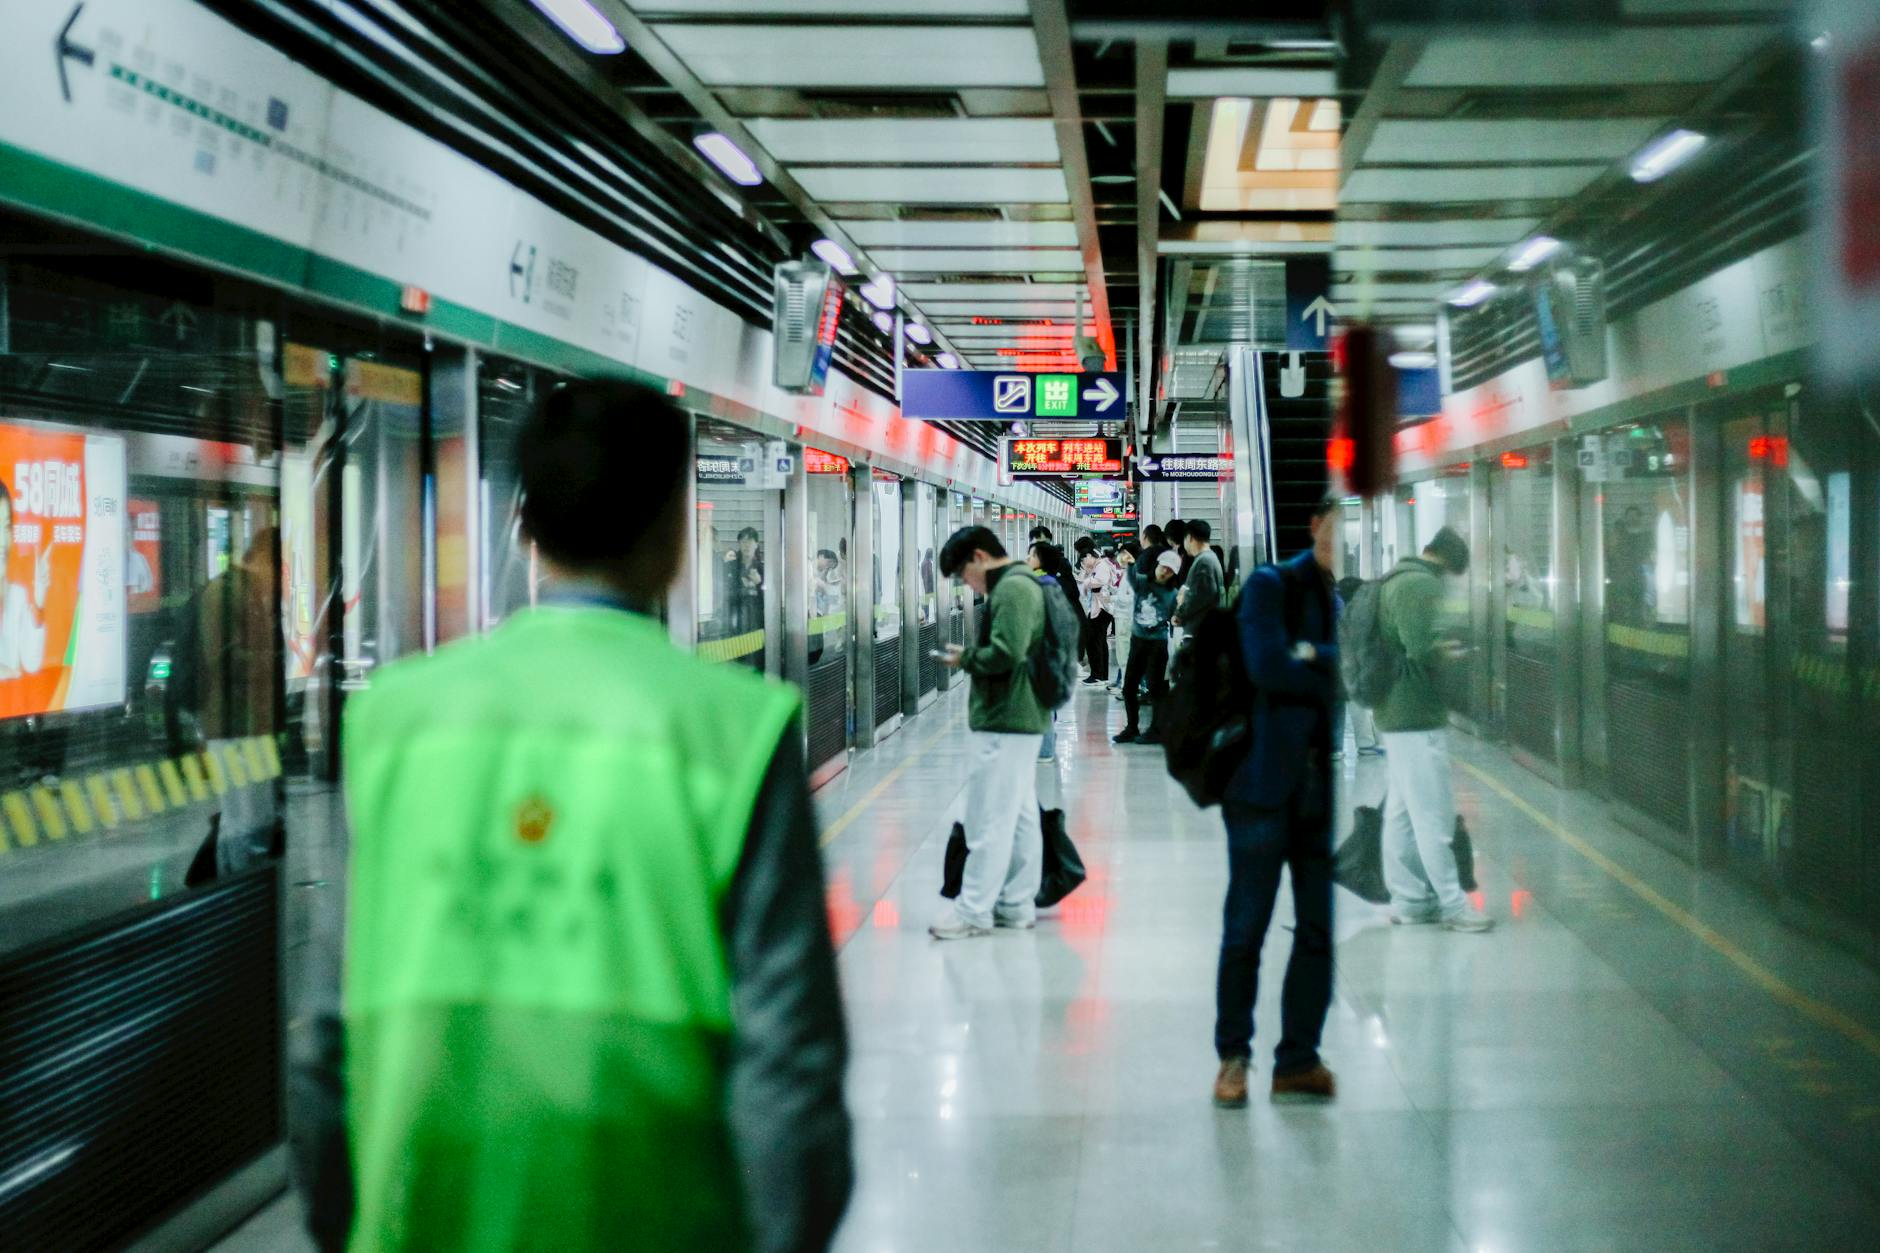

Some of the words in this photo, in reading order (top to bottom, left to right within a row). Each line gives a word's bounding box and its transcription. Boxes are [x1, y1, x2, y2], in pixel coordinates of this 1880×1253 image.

[1045, 401, 1067, 410] EXIT
[1015, 442, 1057, 454] 本次列车
[1063, 442, 1104, 454] 列车进站
[1025, 453, 1047, 463] 开往
